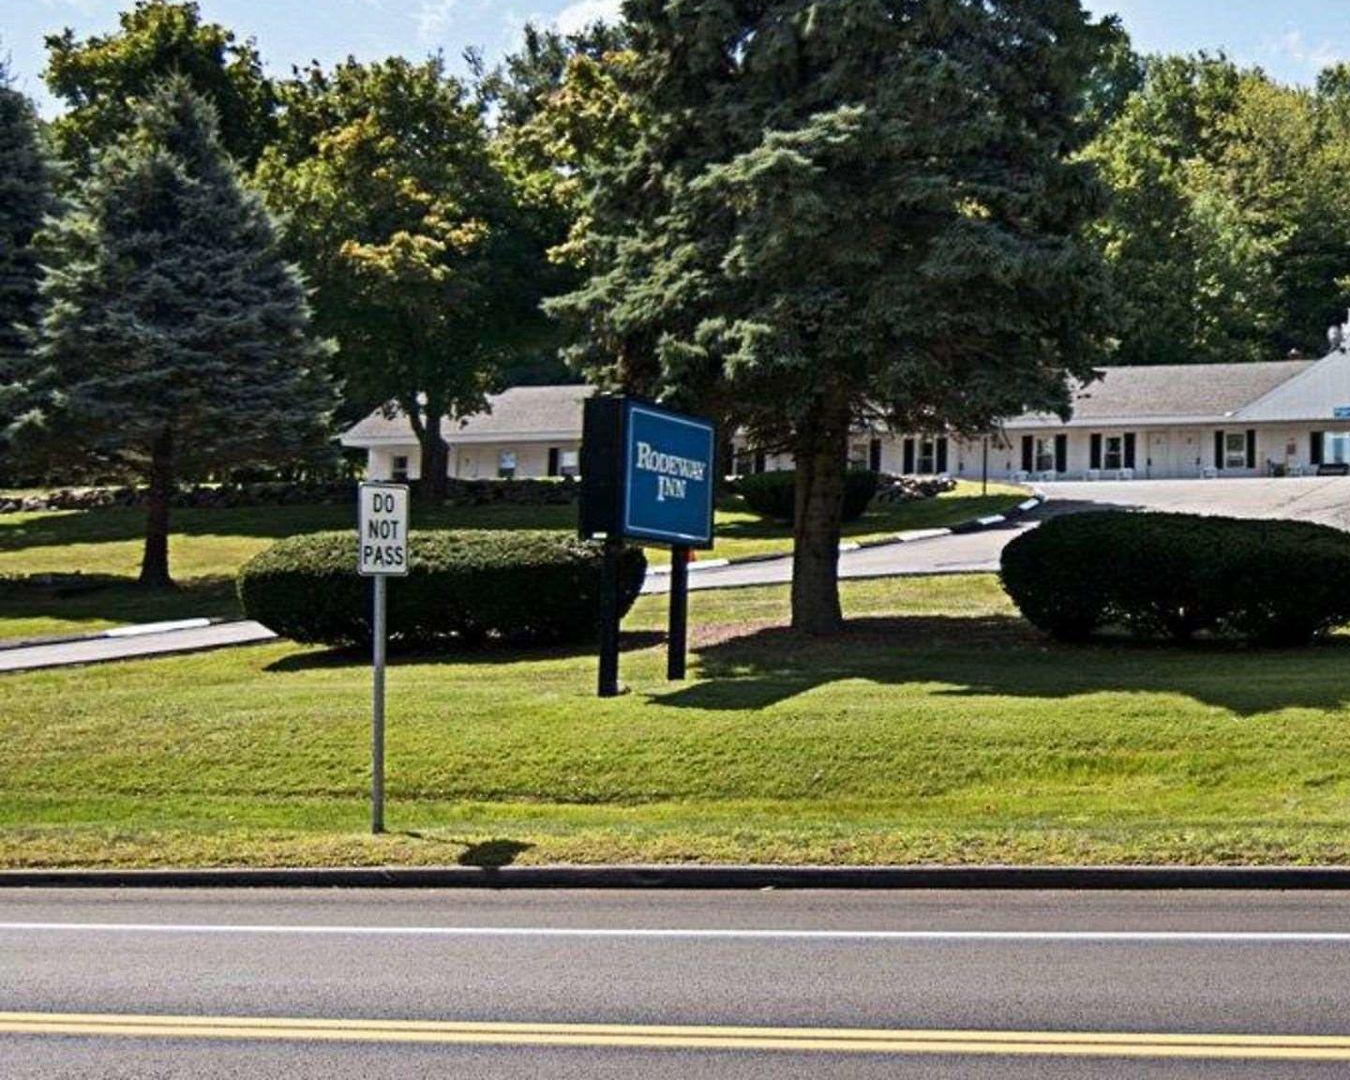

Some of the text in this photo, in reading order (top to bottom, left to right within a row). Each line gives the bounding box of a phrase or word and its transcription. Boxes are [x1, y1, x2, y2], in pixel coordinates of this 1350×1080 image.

[373, 493, 395, 513] DO
[368, 519, 400, 540] NOT
[364, 545, 403, 567] PASS
